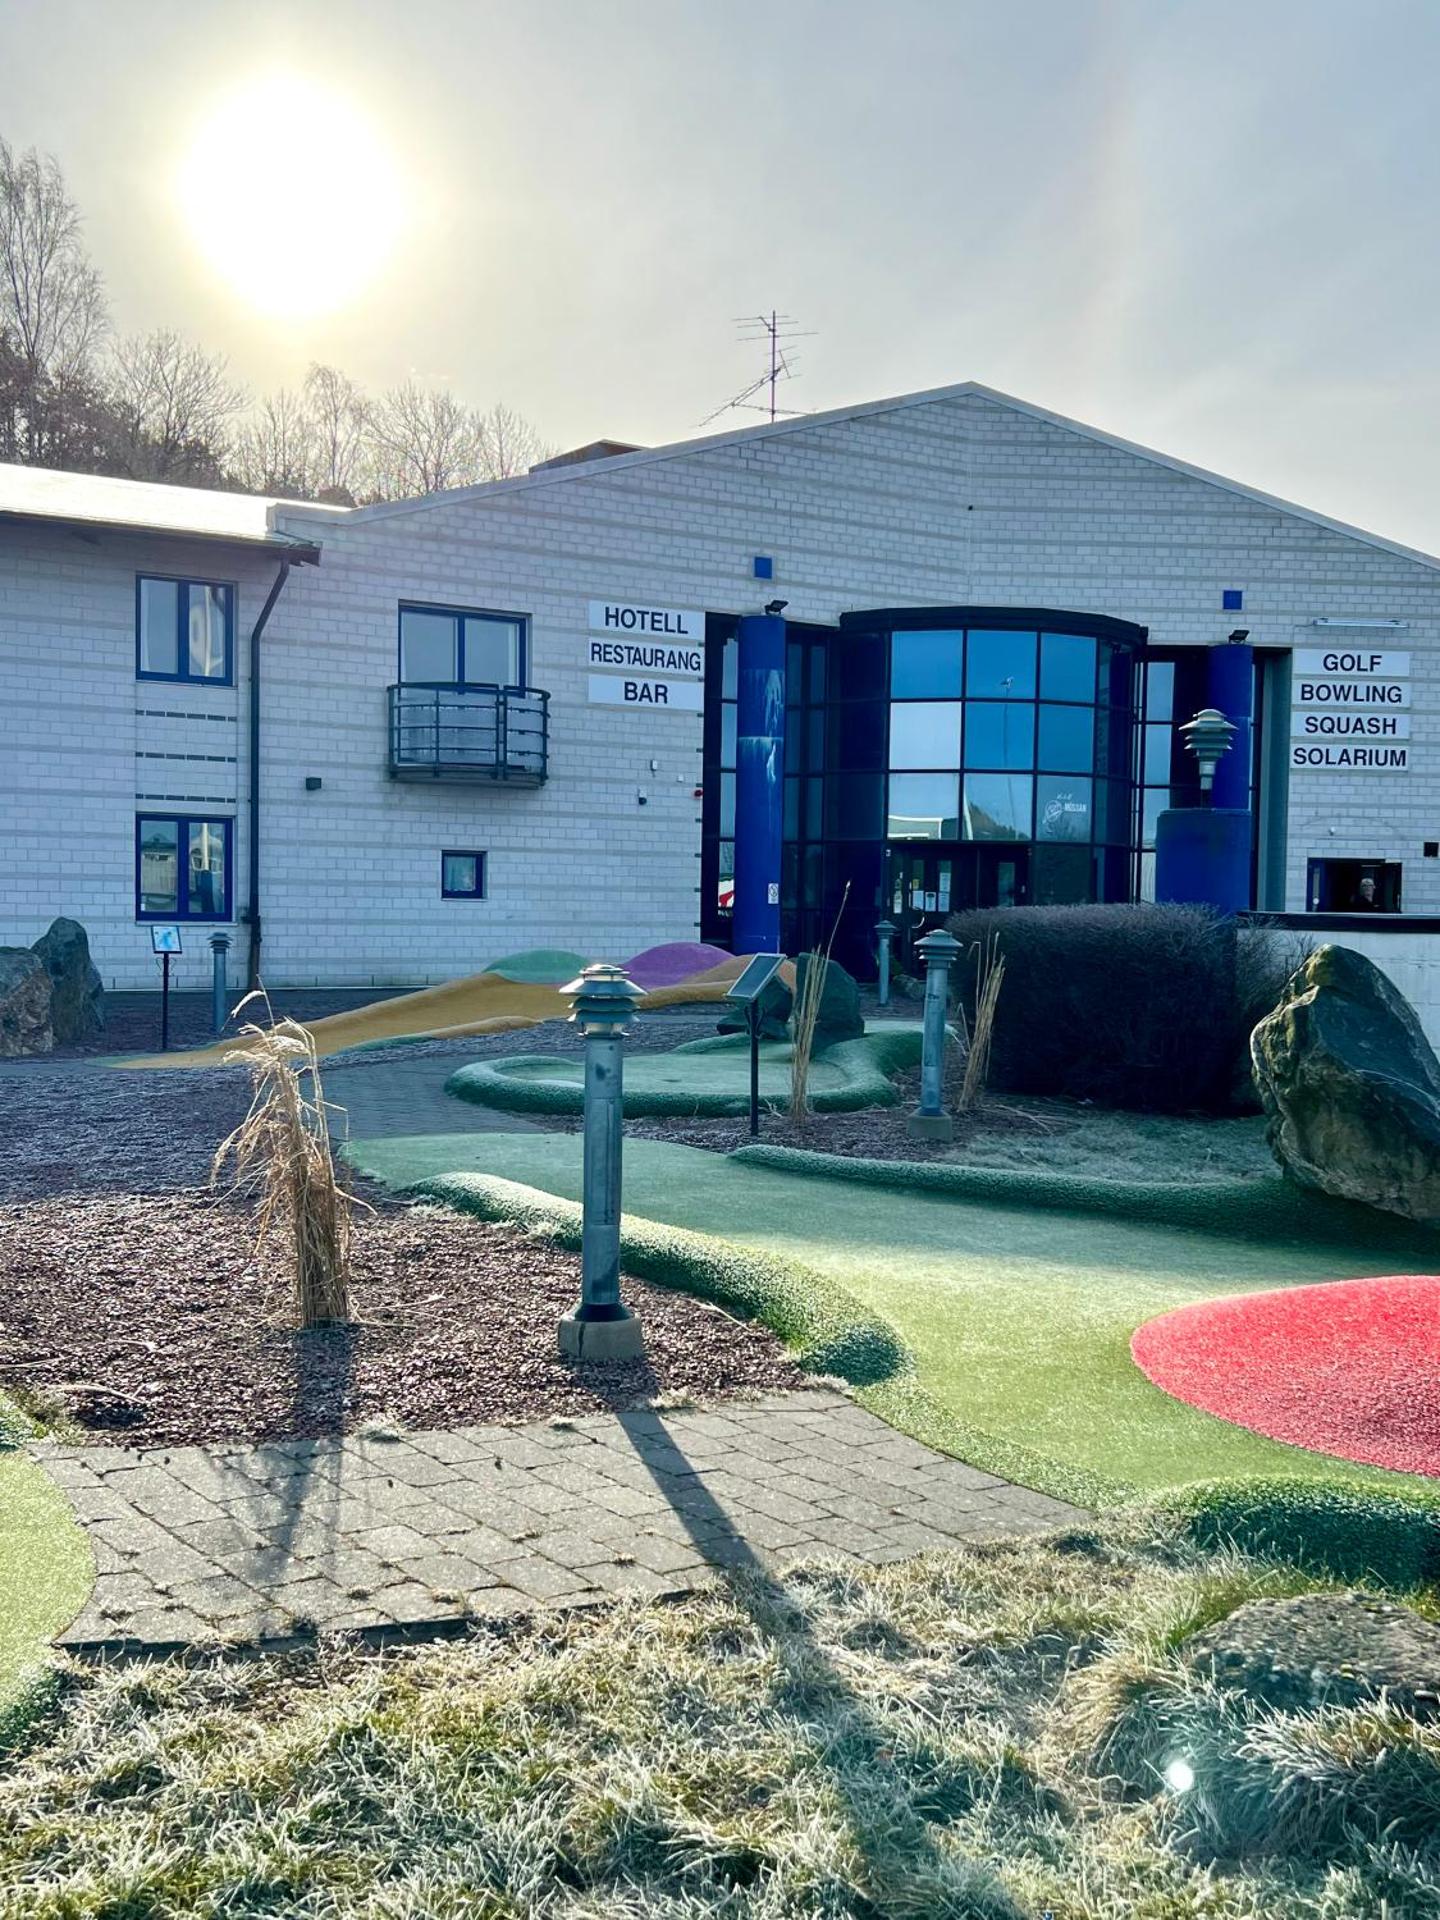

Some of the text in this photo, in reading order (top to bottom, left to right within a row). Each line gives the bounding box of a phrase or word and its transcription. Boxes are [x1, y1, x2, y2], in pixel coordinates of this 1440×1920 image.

[605, 606, 688, 634] HOTELL
[591, 643, 700, 671] RESTAURANG
[1323, 654, 1382, 672] GOLF
[624, 682, 668, 704] BAR
[1301, 684, 1402, 703] BOWLING
[1305, 716, 1396, 735] SQUASH
[1293, 748, 1406, 766] SOLARIUM
